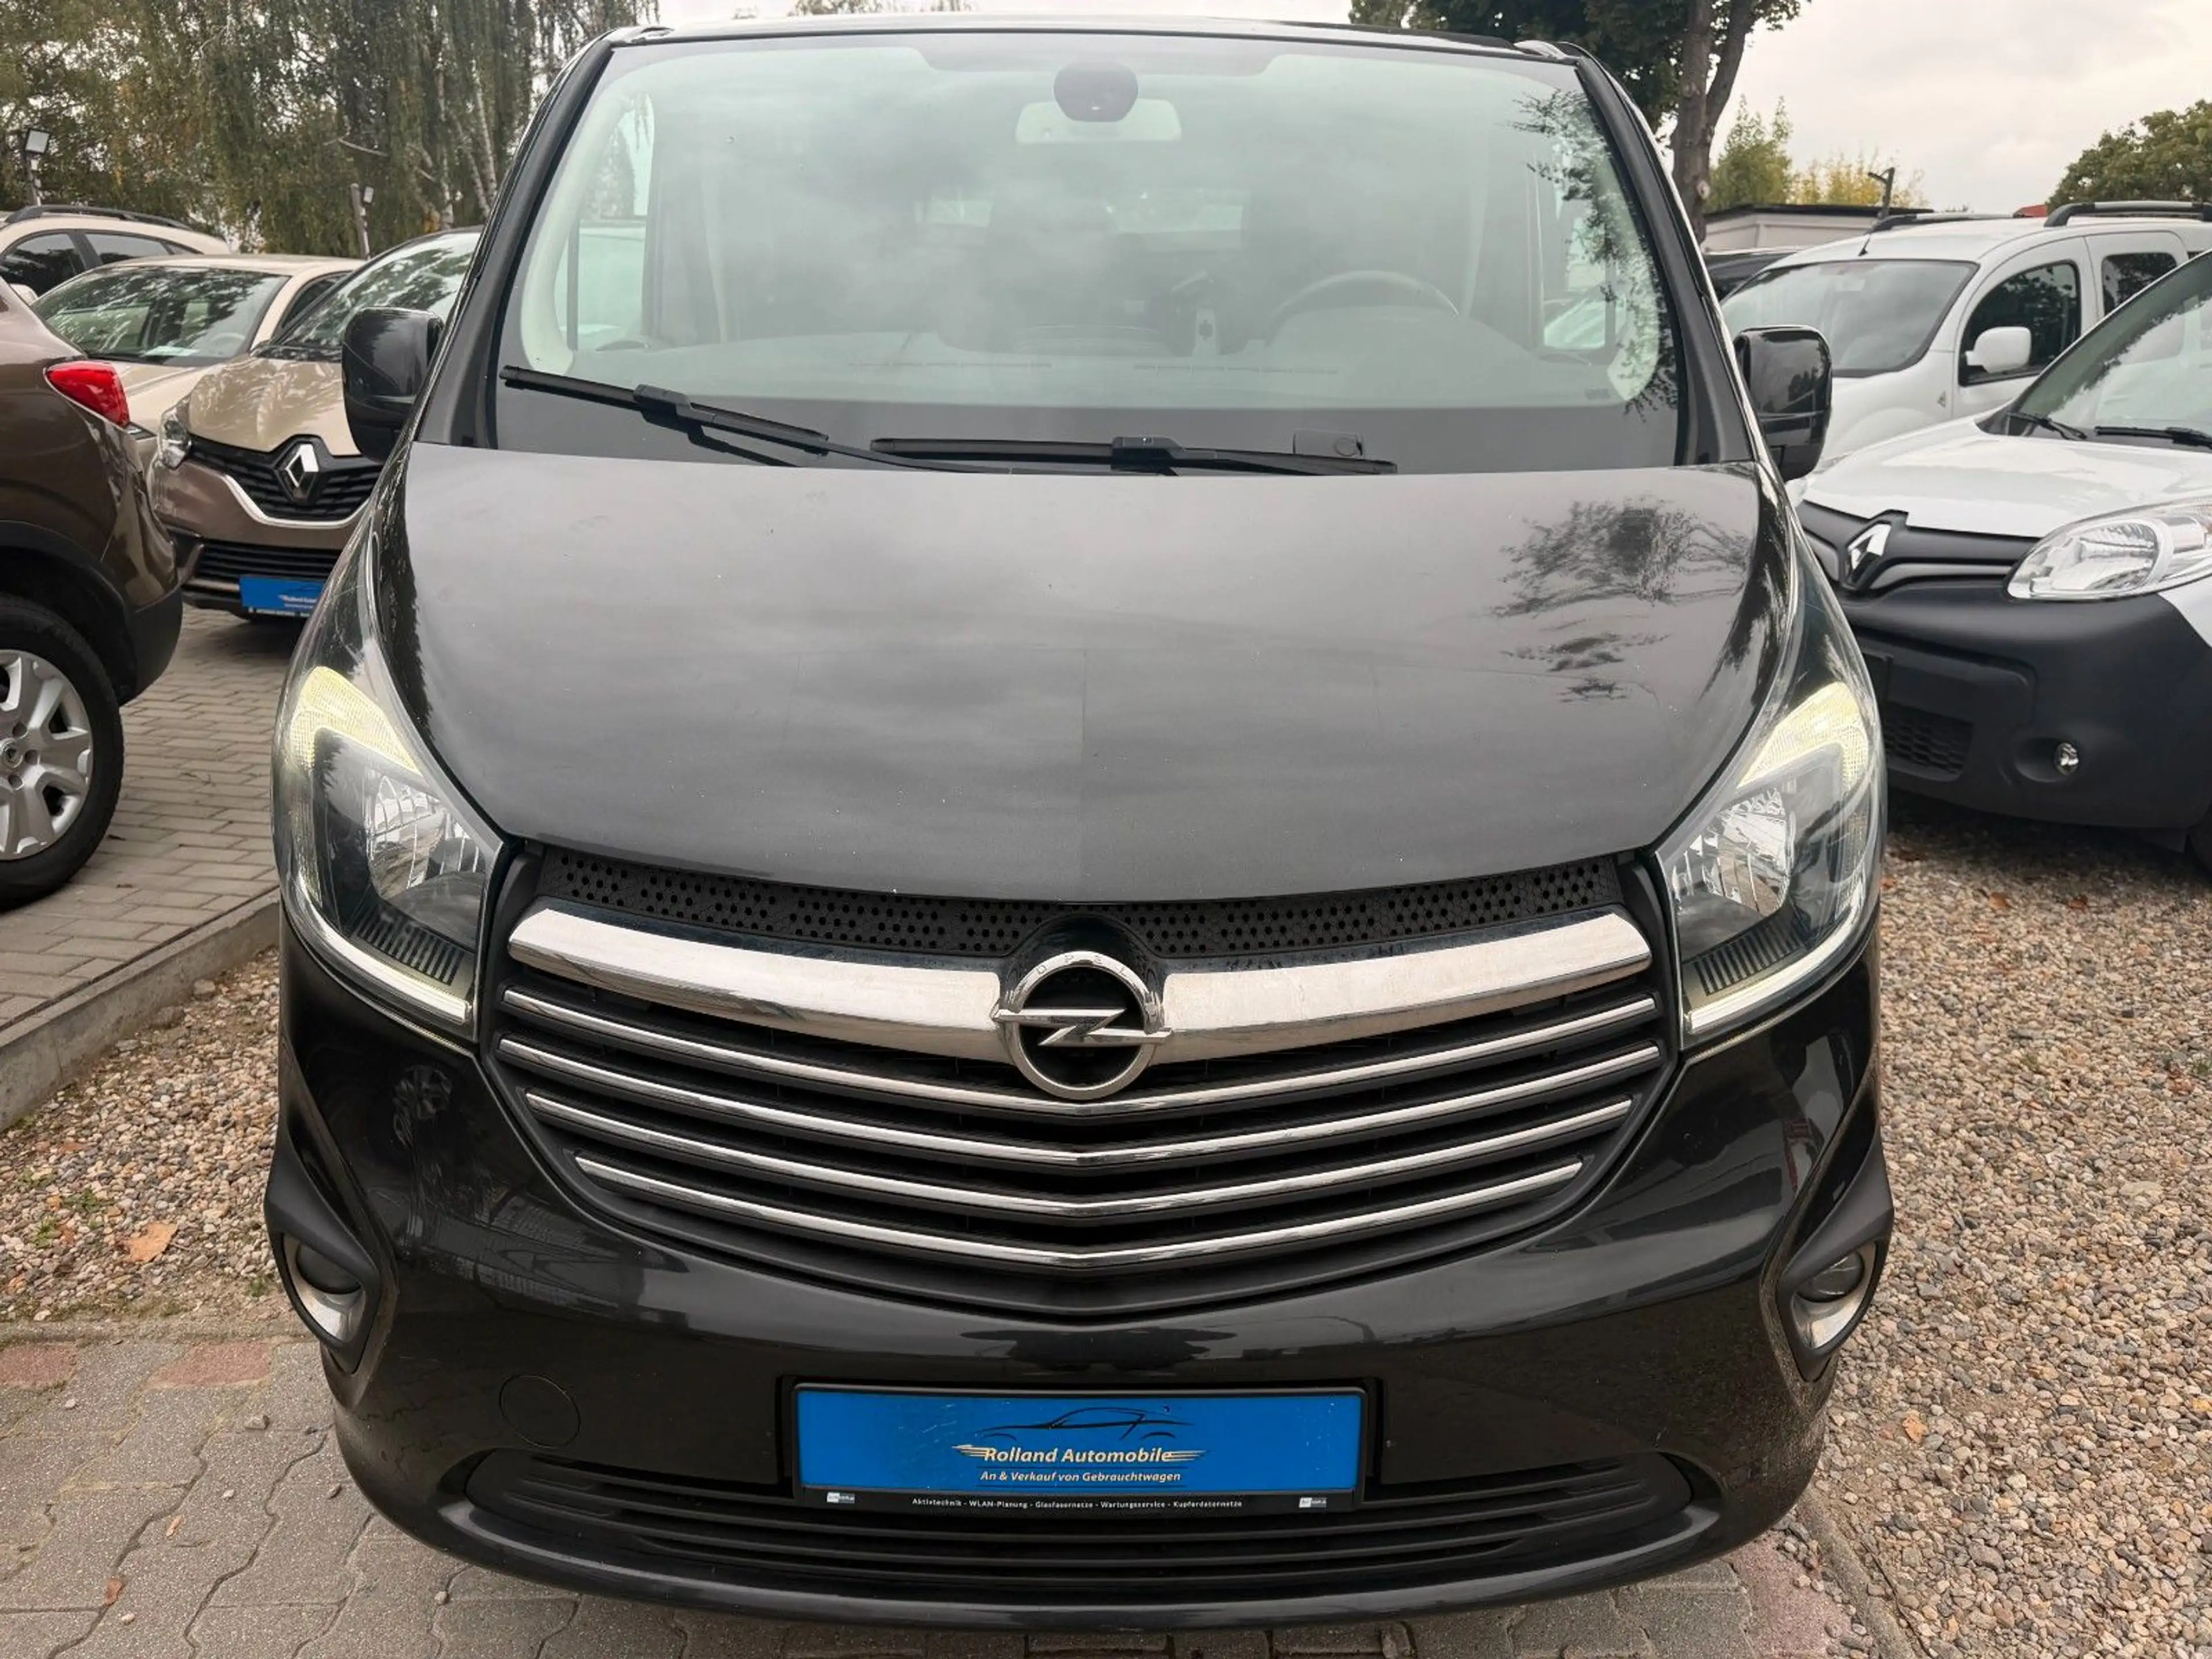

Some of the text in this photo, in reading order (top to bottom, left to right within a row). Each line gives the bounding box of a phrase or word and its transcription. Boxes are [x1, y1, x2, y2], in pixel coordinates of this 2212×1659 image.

[1036, 954, 1127, 978] OPEL
[984, 1446, 1173, 1463] Rolland Automobile
[980, 1471, 1181, 1483] An & Verkauf von Gebrauchtwagen
